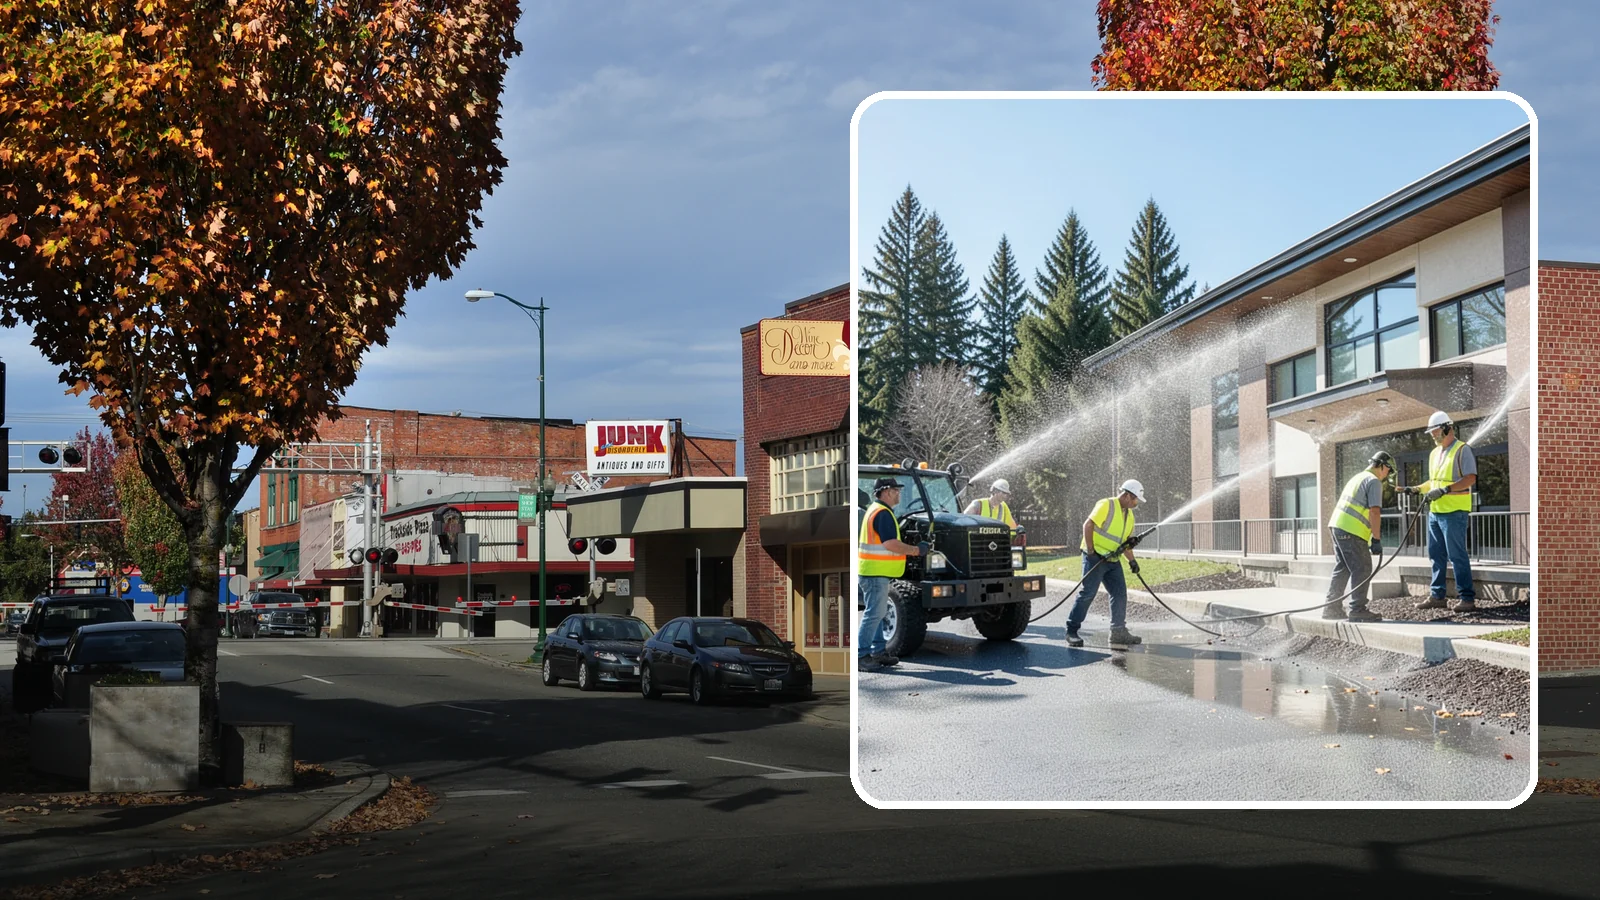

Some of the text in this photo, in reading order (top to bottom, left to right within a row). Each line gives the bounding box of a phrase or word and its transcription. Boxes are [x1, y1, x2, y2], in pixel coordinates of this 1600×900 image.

[595, 425, 665, 457] JUNK
[597, 460, 665, 470] ANTIQUES AND GIFTS
[390, 519, 429, 540] Trackside Pizza
